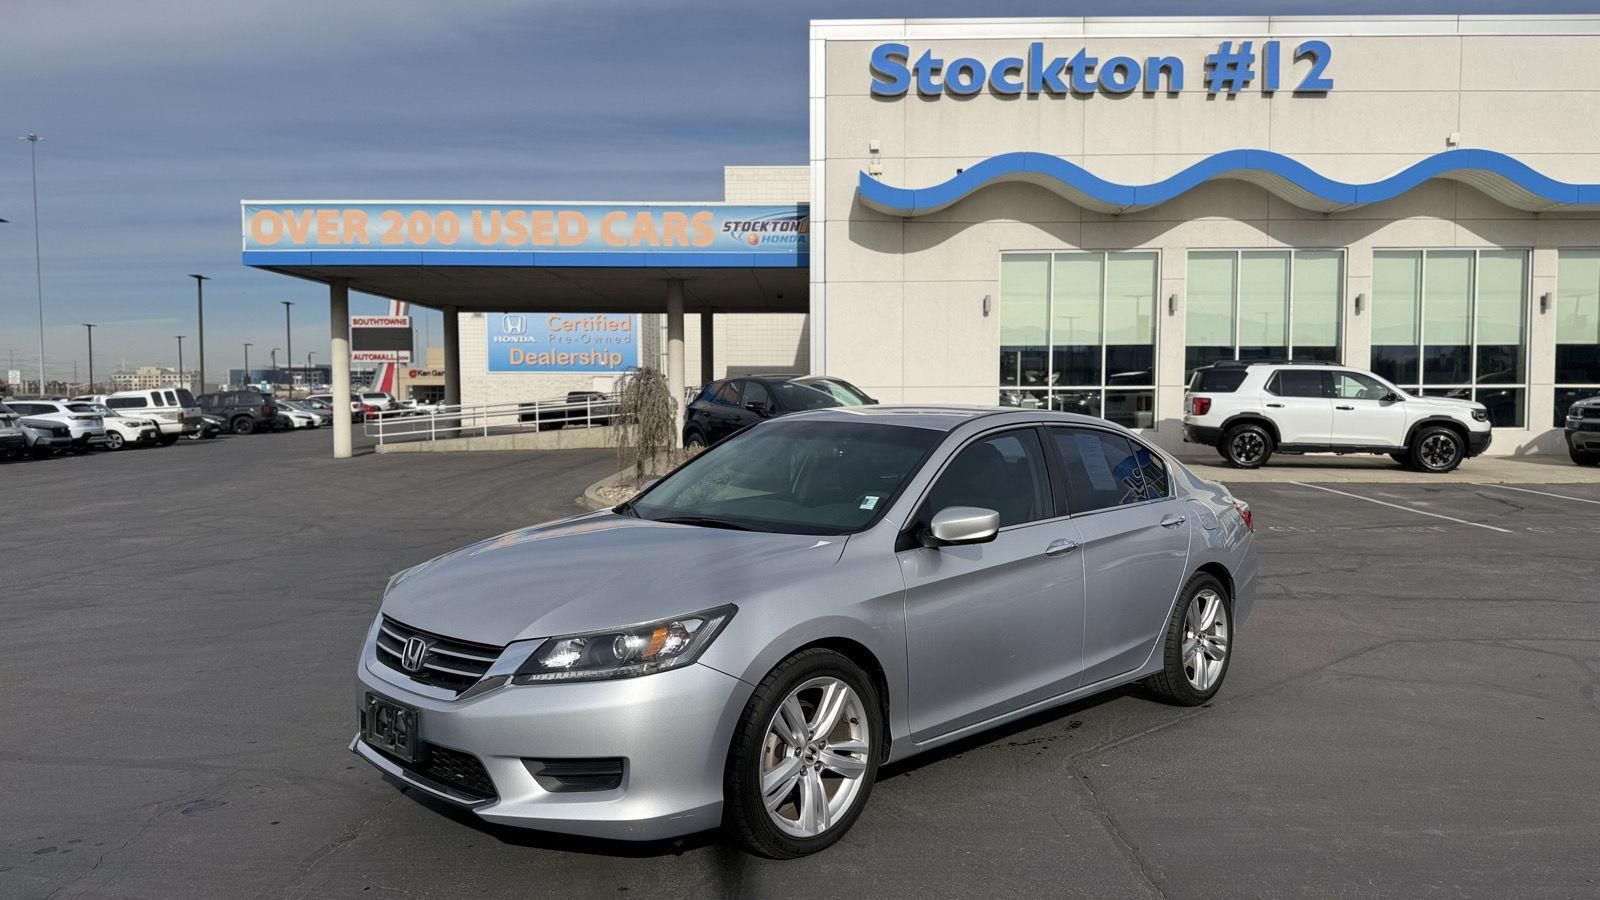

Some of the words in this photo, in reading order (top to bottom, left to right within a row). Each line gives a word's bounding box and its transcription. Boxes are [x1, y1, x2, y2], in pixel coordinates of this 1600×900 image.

[869, 42, 1184, 97] Stockton
[1205, 40, 1334, 97] #12
[251, 209, 369, 246] OVER
[379, 210, 460, 246] 200
[470, 209, 589, 246] USED
[600, 210, 715, 247] CARS
[761, 234, 806, 244] HONDA
[352, 318, 408, 326] SOUTHTOWNE
[546, 313, 633, 332] Certified
[493, 335, 537, 343] HONDA
[548, 333, 633, 344] Pre-Owned
[509, 348, 623, 367] Dealership
[417, 369, 432, 377] Ken
